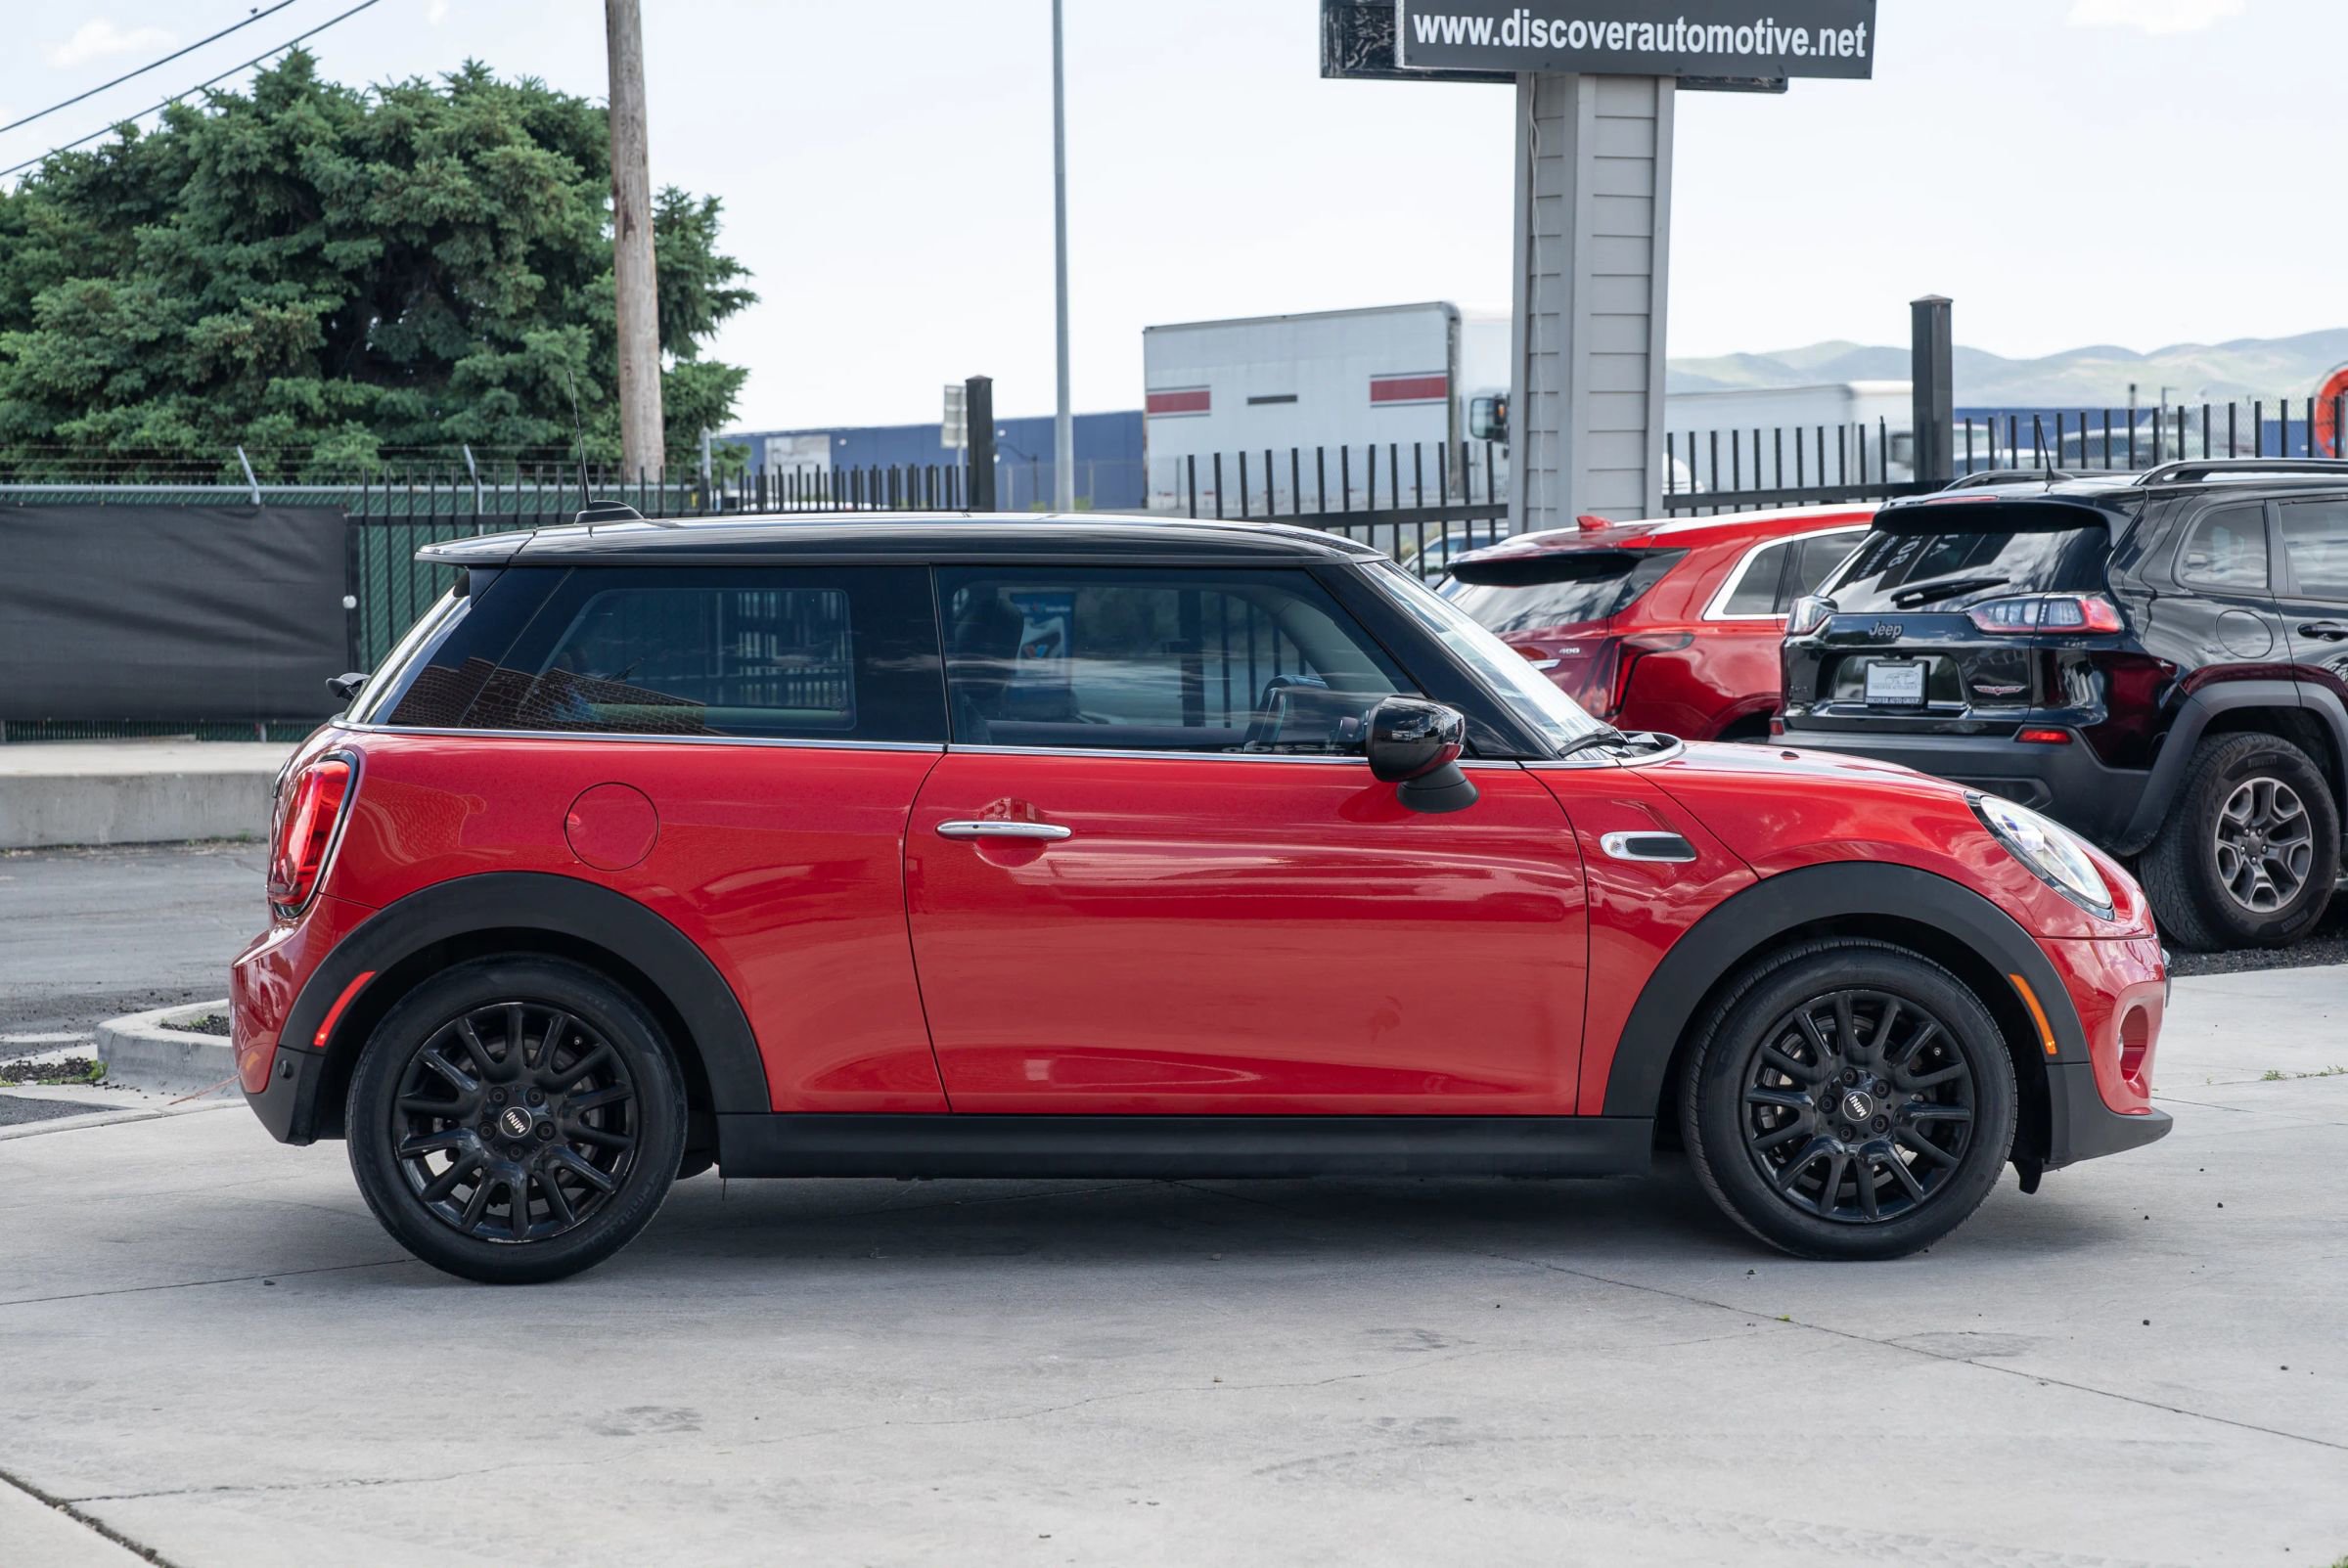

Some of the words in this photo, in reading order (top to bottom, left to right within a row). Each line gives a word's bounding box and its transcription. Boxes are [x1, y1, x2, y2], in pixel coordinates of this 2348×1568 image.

[1413, 8, 1867, 58] www.discoverautomotive.net
[1869, 621, 1903, 639] Jeep
[1849, 1095, 1868, 1117] MINI
[506, 1111, 526, 1134] MINI
